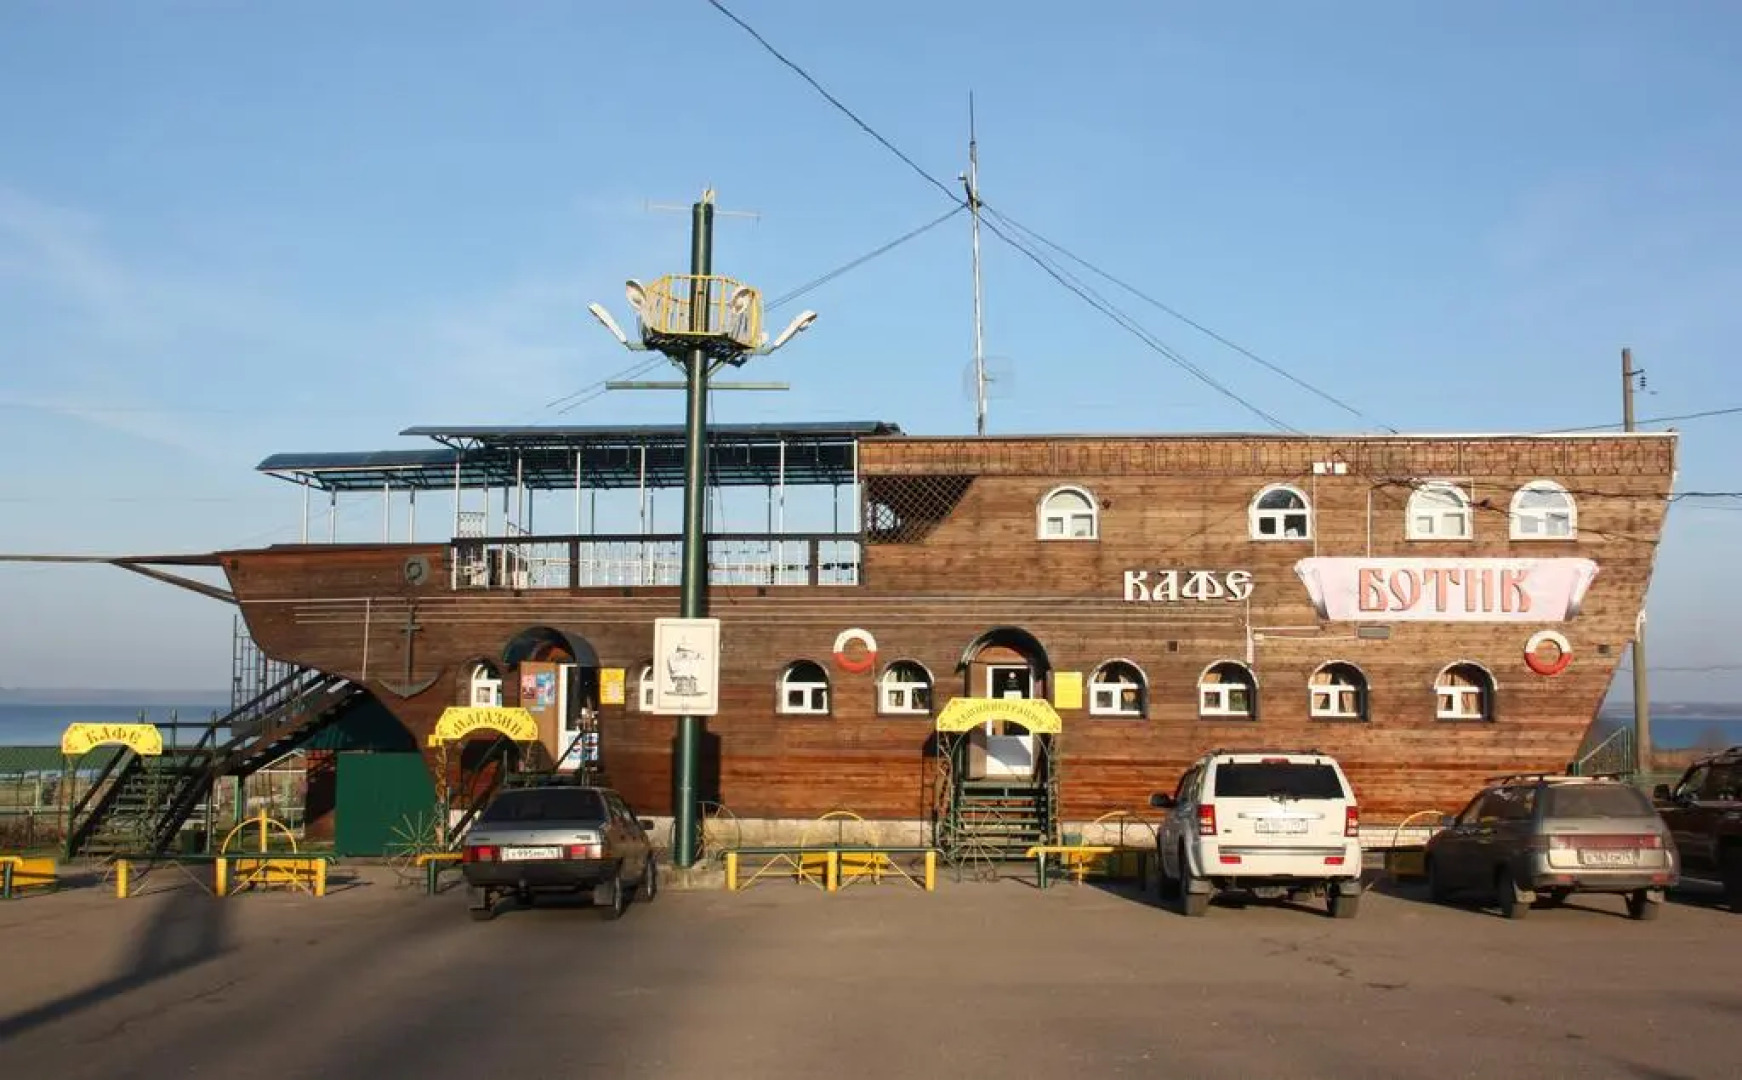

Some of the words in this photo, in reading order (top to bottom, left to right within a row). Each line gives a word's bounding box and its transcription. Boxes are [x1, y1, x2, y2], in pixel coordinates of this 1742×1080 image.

[1123, 569, 1254, 602] КАФЕ
[1358, 568, 1532, 613] БОТИК
[86, 725, 138, 744] КАФЕ
[453, 711, 522, 736] МАГАЗИН
